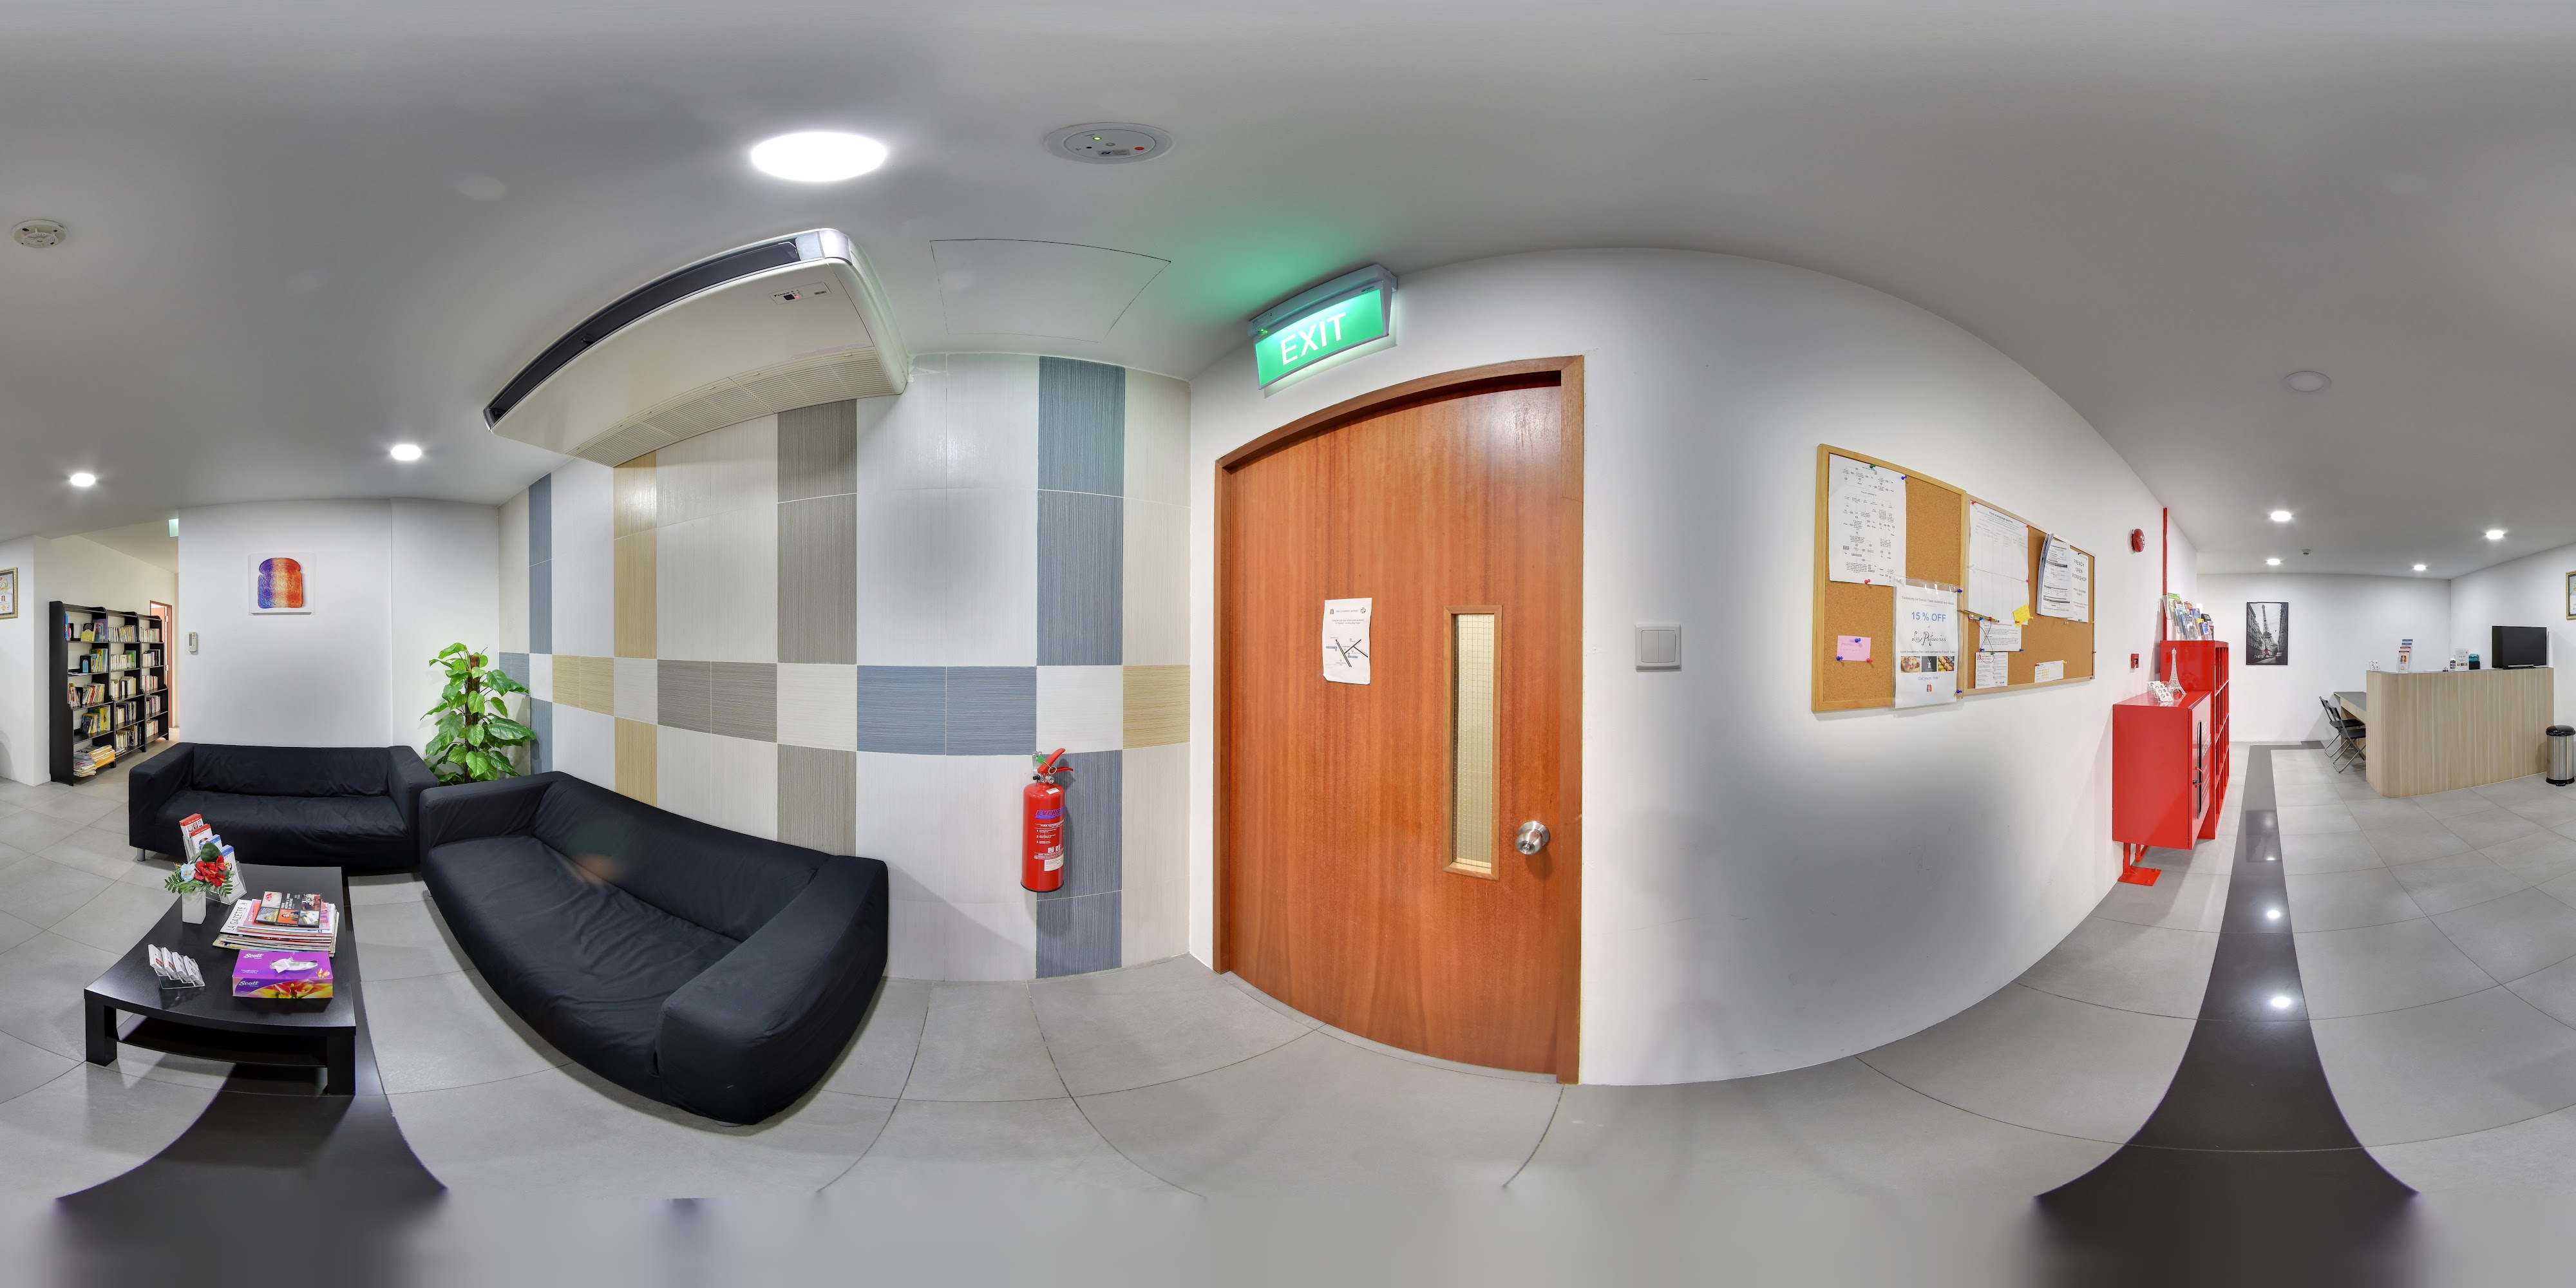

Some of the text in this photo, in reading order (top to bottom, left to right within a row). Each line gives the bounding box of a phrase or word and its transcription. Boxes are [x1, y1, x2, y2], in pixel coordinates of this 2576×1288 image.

[1280, 312, 1346, 366] EXIT
[1911, 611, 1946, 622] 15 % OFF
[230, 907, 245, 925] GAZETTE
